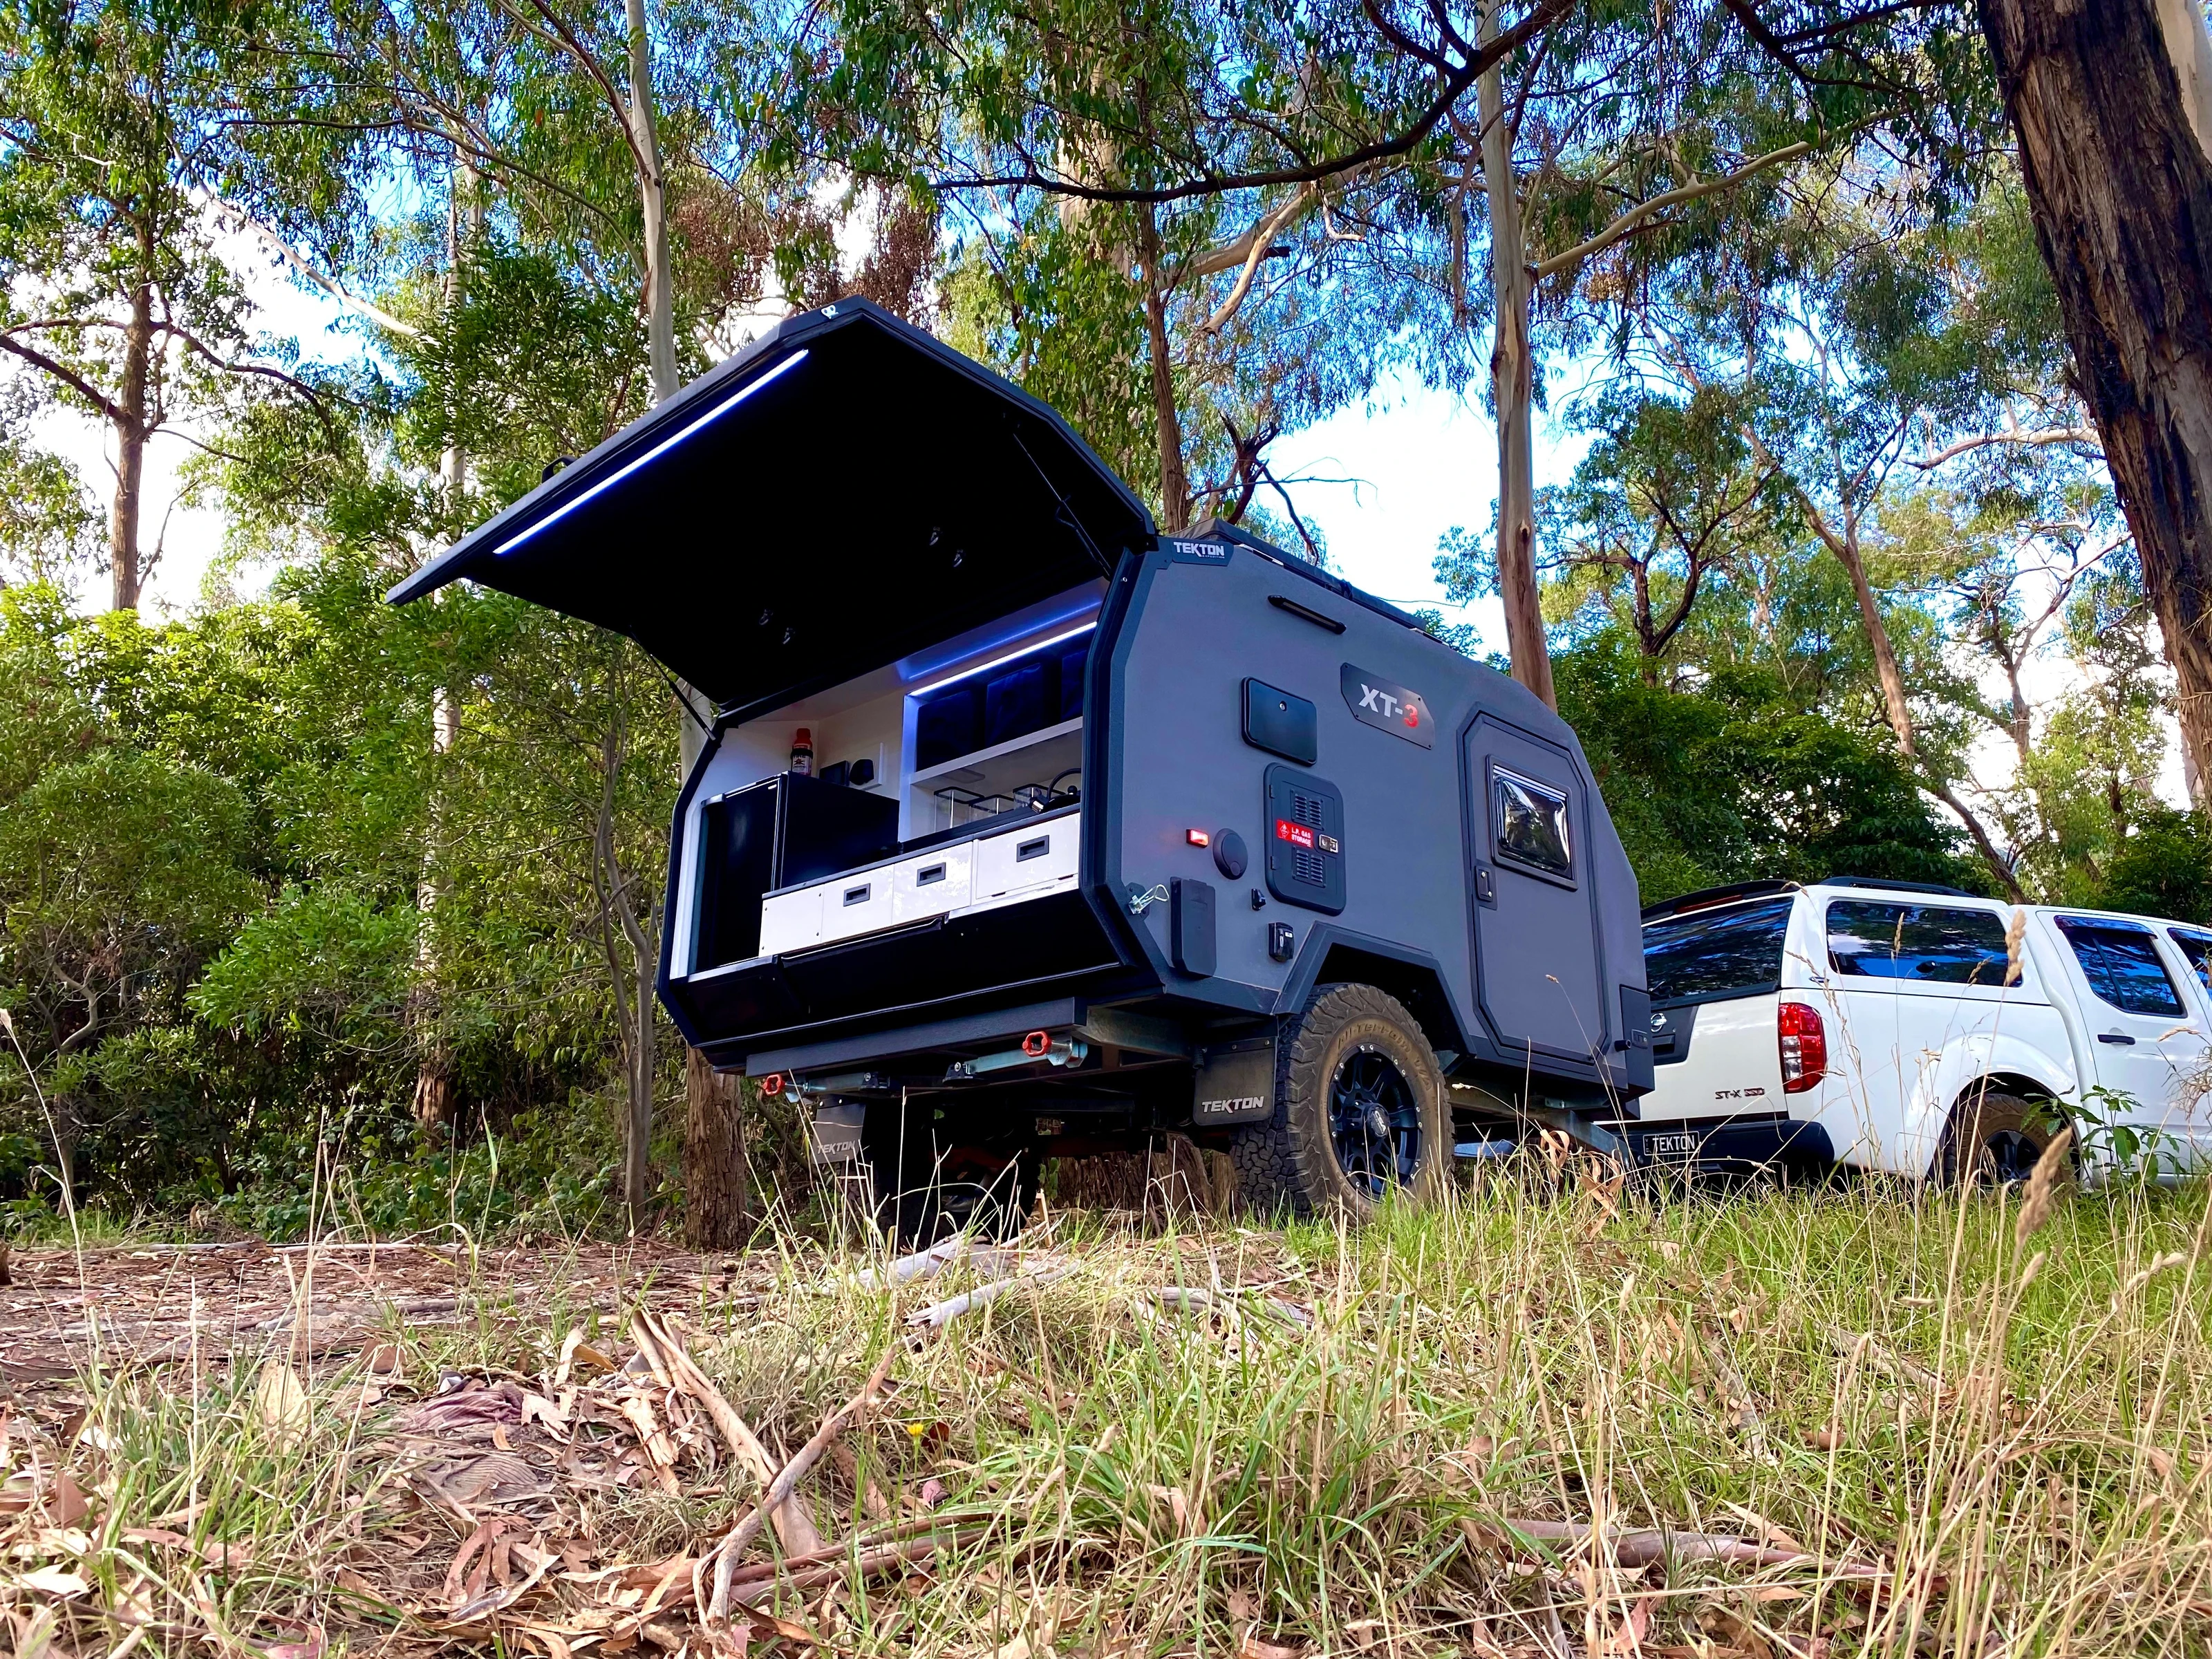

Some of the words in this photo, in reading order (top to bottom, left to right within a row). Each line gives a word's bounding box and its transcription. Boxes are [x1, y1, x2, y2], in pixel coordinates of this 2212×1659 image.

[1173, 541, 1225, 557] TEKTON
[1358, 683, 1418, 728] XT-3
[1291, 834, 1311, 845] STORAGE
[1301, 830, 1311, 838] GAS
[1715, 1089, 1742, 1100] ST-X
[1201, 1096, 1264, 1114] TEKTON
[817, 1140, 856, 1155] TEKTON
[1652, 1134, 1696, 1152] TEKTON
